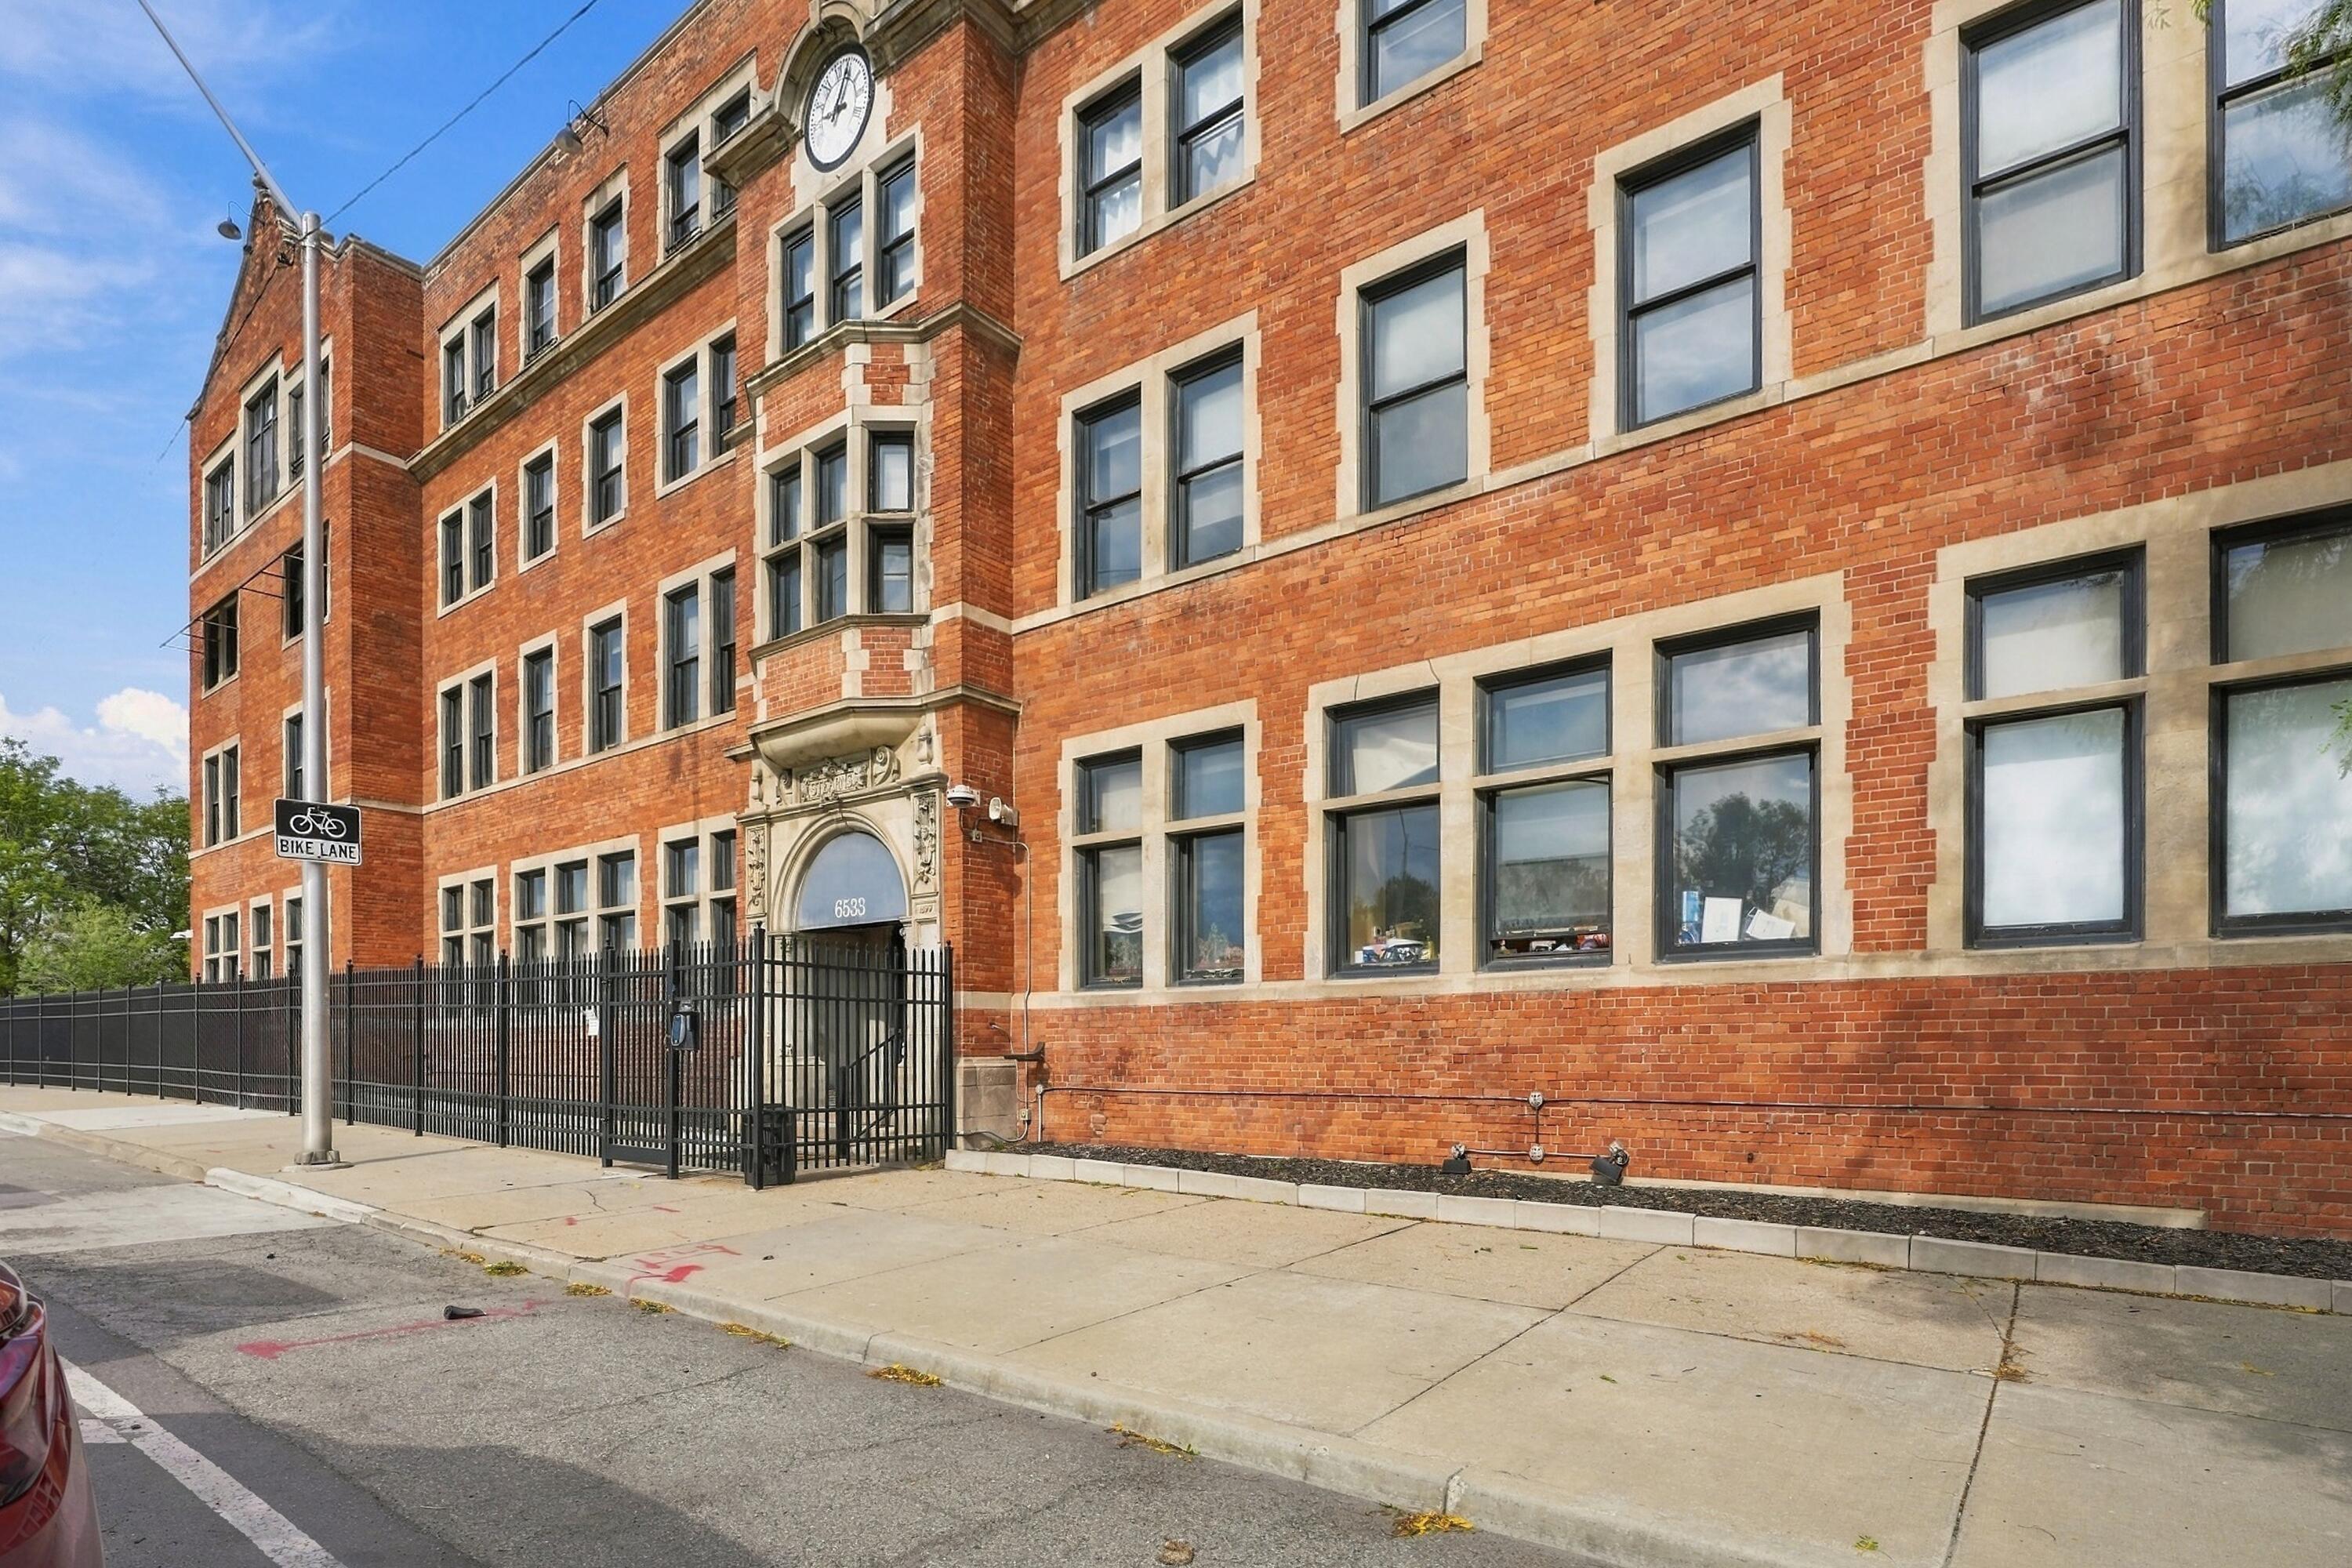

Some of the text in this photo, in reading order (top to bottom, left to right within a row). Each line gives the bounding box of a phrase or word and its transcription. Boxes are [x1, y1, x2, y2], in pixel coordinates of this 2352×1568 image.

[280, 839, 357, 859] BIKE LANE
[834, 897, 866, 919] 6533
